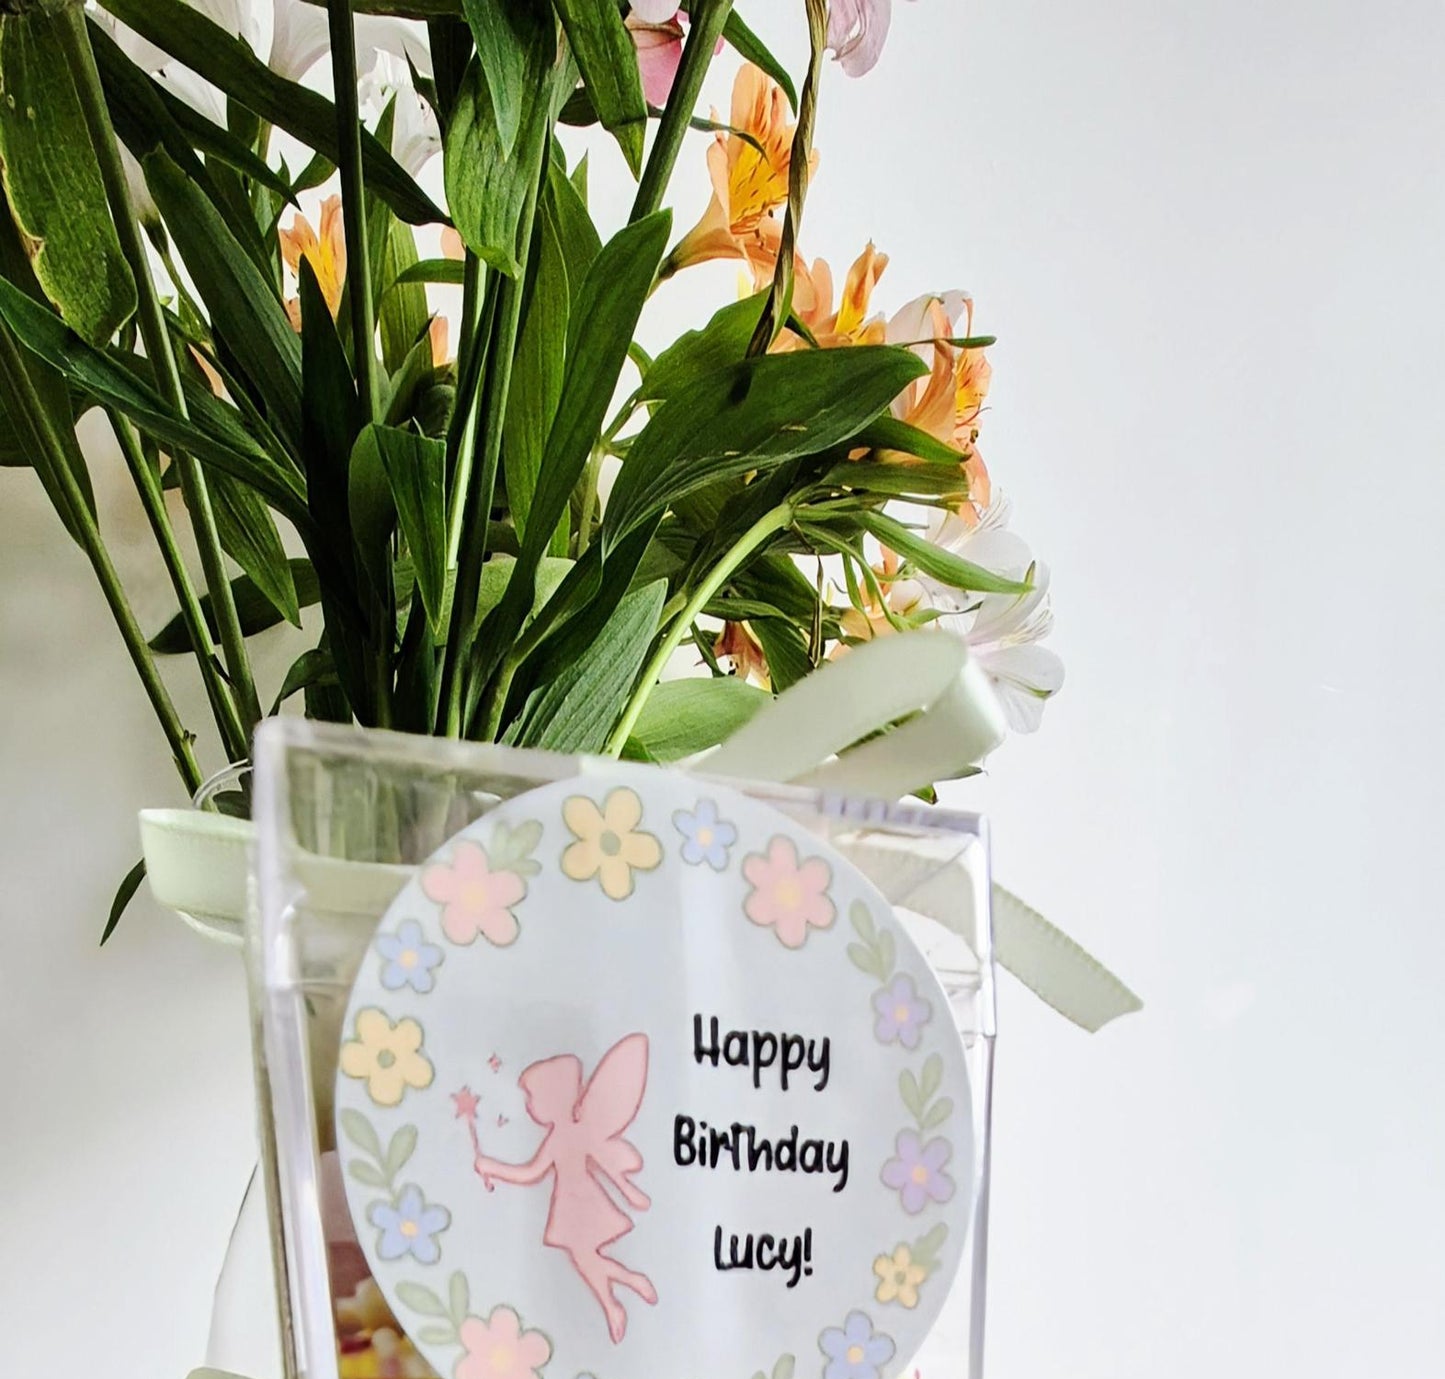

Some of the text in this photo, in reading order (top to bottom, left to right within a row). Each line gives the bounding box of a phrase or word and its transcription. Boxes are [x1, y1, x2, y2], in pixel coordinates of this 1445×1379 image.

[692, 1013, 832, 1093] Happy
[672, 1113, 851, 1193] Birthday
[712, 1224, 814, 1289] Lucy!
